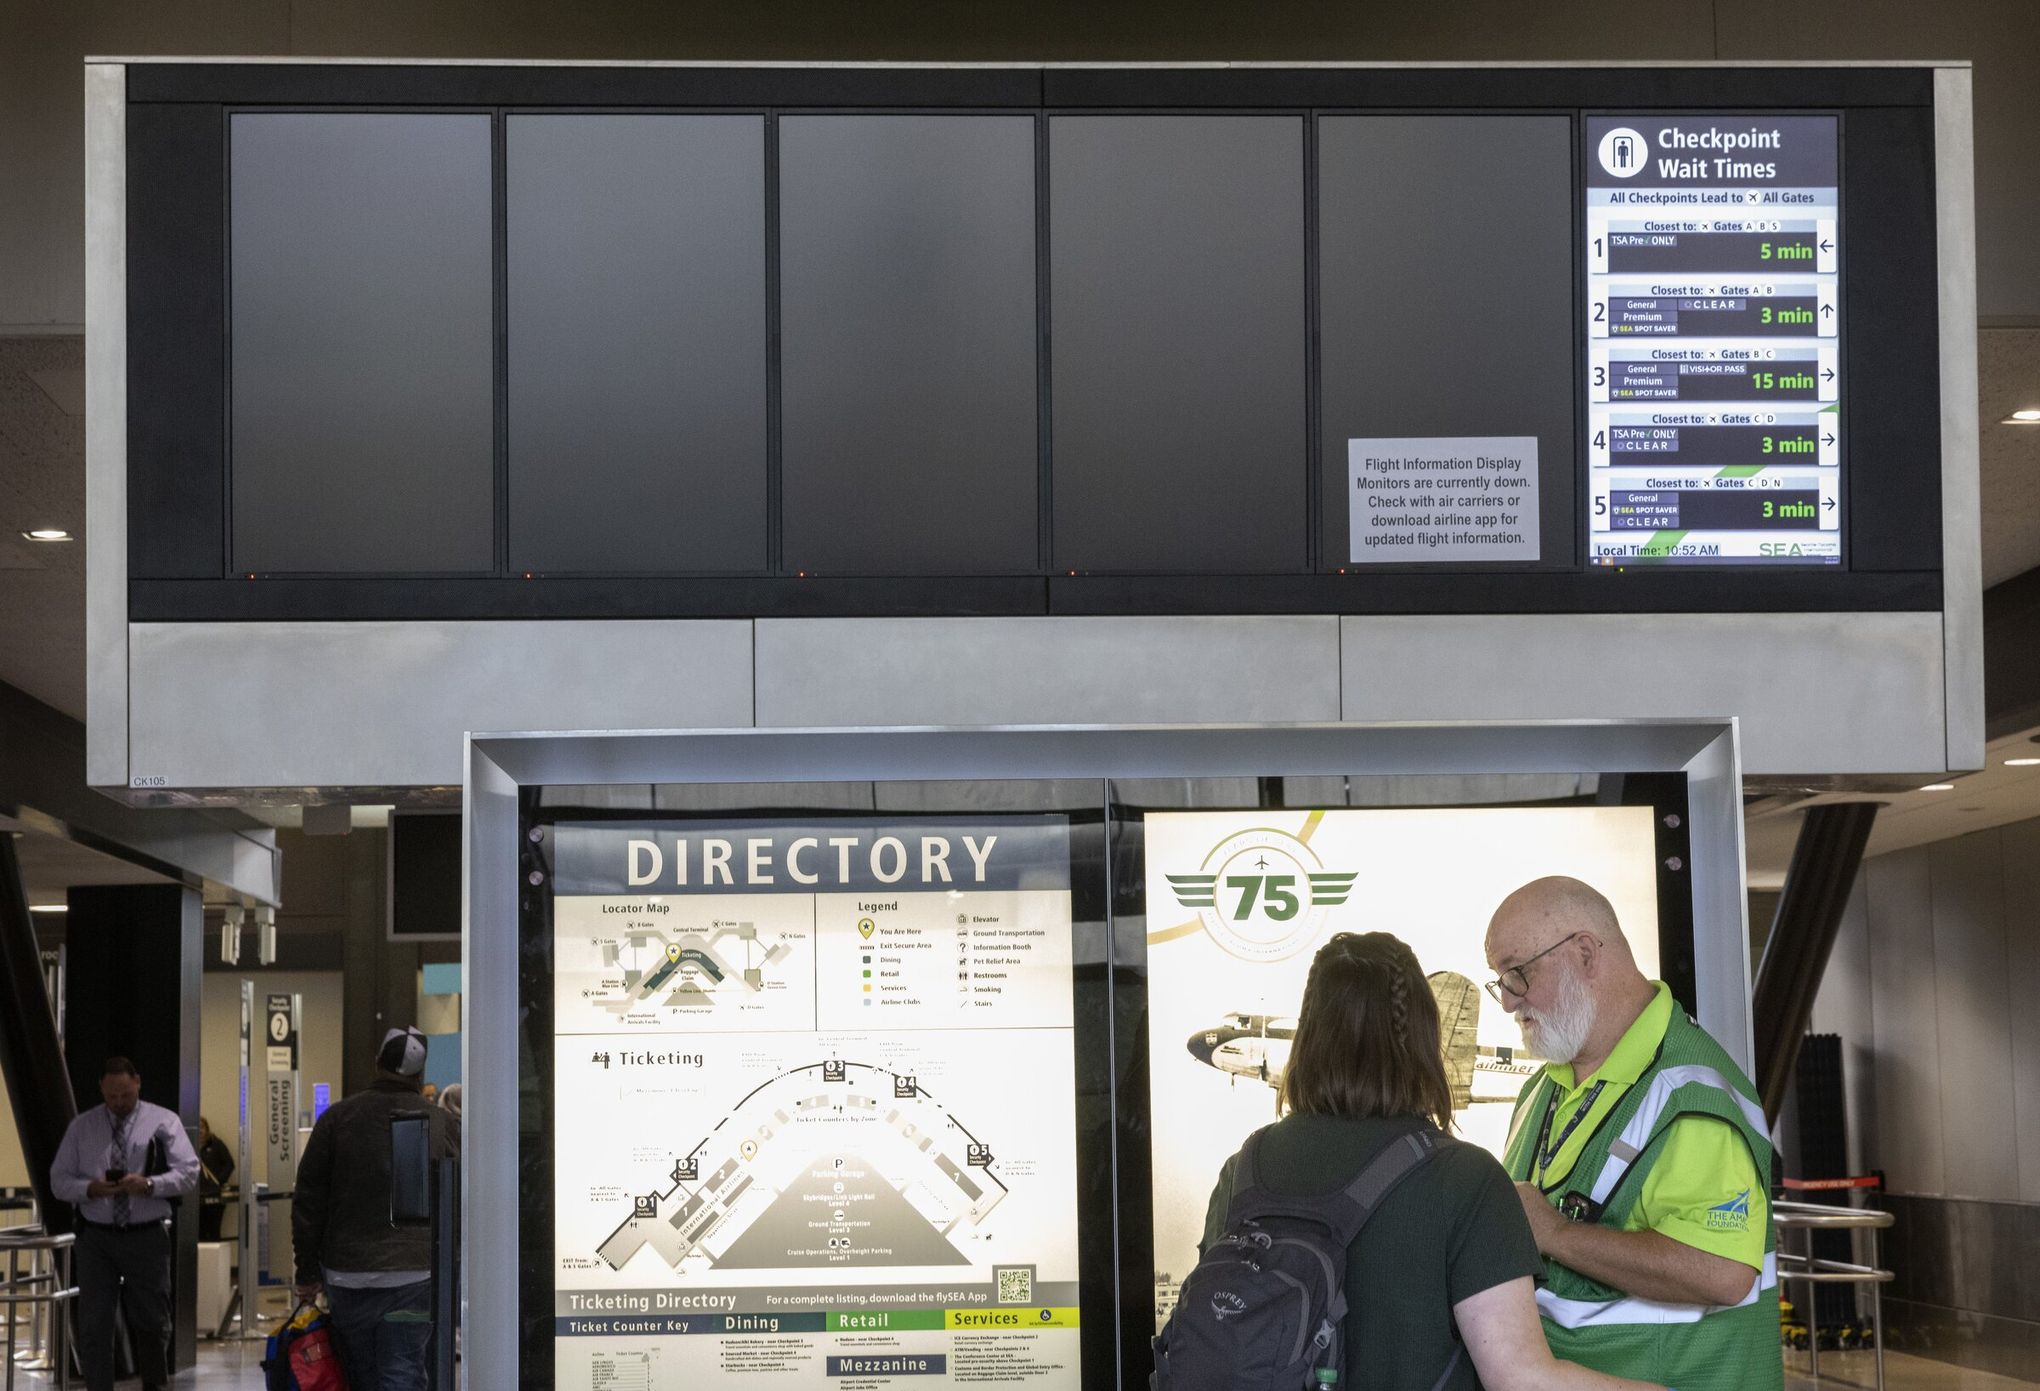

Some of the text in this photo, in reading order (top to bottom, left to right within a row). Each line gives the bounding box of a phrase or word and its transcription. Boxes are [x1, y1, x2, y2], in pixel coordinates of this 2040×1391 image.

[1658, 128, 1781, 153] Checkpoint
[1658, 158, 1776, 178] Wait Times
[1610, 192, 1815, 206] All Checkpoints Lead to All Gates
[1644, 222, 1777, 231] Closest to: Gates A B S
[1612, 236, 1674, 245] TSA Pre ONLY
[1594, 238, 1602, 257] 1
[1761, 243, 1813, 259] 5 min
[1651, 286, 1687, 295] Closest
[1690, 286, 1703, 295] to:
[1720, 286, 1749, 295] Gates
[1627, 300, 1656, 309] General
[1694, 301, 1736, 309] CLEAR
[1594, 303, 1605, 322] 2
[1623, 312, 1662, 321] Premium
[1761, 308, 1813, 323] 3 min
[1627, 364, 1657, 373] General
[1724, 365, 1745, 373] PASS
[1594, 367, 1605, 386] 3
[1624, 376, 1662, 385] Premium
[1753, 373, 1814, 389] 15 min
[1593, 430, 1606, 449] 4
[1613, 429, 1676, 439] TSA Pre ONLY
[1626, 442, 1668, 450] CLEAR
[1762, 437, 1815, 453] 3 min
[1366, 457, 1521, 473] Flight Information Display
[1357, 476, 1530, 490] Monitors are currently down.
[1646, 478, 1682, 488] Closest
[1685, 479, 1698, 488] to:
[1716, 479, 1745, 488] Gates
[1774, 479, 1780, 487] N
[1368, 495, 1520, 508] Check with air carriers or
[1629, 494, 1658, 502] General
[1595, 496, 1606, 515] 5
[1763, 501, 1815, 517] 3 min
[1371, 513, 1518, 528] download airline app for
[1627, 518, 1668, 526] CLEAR
[1365, 531, 1525, 547] updated flight information.
[1597, 545, 1719, 556] Local Time: 10:52 AM
[1759, 543, 1802, 556] SEA
[134, 776, 165, 786] CK105
[628, 836, 998, 886] DIRECTORY
[1226, 875, 1299, 921] 75
[602, 903, 670, 914] Locator Map
[858, 901, 898, 913] Legend
[880, 956, 901, 964] Dining
[974, 986, 1001, 994] Smoking
[276, 1018, 283, 1036] 2
[620, 1051, 704, 1067] Ticketing
[837, 1061, 844, 1071] 3
[908, 1078, 915, 1087] 4
[269, 1080, 279, 1145] General
[280, 1080, 291, 1162] Screening
[981, 1145, 987, 1155] 5
[690, 1160, 697, 1170] 2
[680, 1197, 721, 1237] International
[1708, 1212, 1728, 1221] THE
[570, 1293, 737, 1311] Ticketing Directory
[766, 1294, 783, 1305] For
[790, 1293, 834, 1306] complete
[836, 1292, 868, 1306] listing,
[870, 1291, 917, 1303] download
[919, 1292, 934, 1302] the
[936, 1291, 965, 1304] flySEA
[969, 1291, 987, 1304] App
[1214, 1291, 1247, 1309] OSPREY
[726, 1316, 779, 1331] Dining
[840, 1314, 889, 1327] Retail
[954, 1312, 1018, 1325] Services
[570, 1320, 689, 1332] Ticket Counter Key
[840, 1357, 927, 1372] Mezzanine
